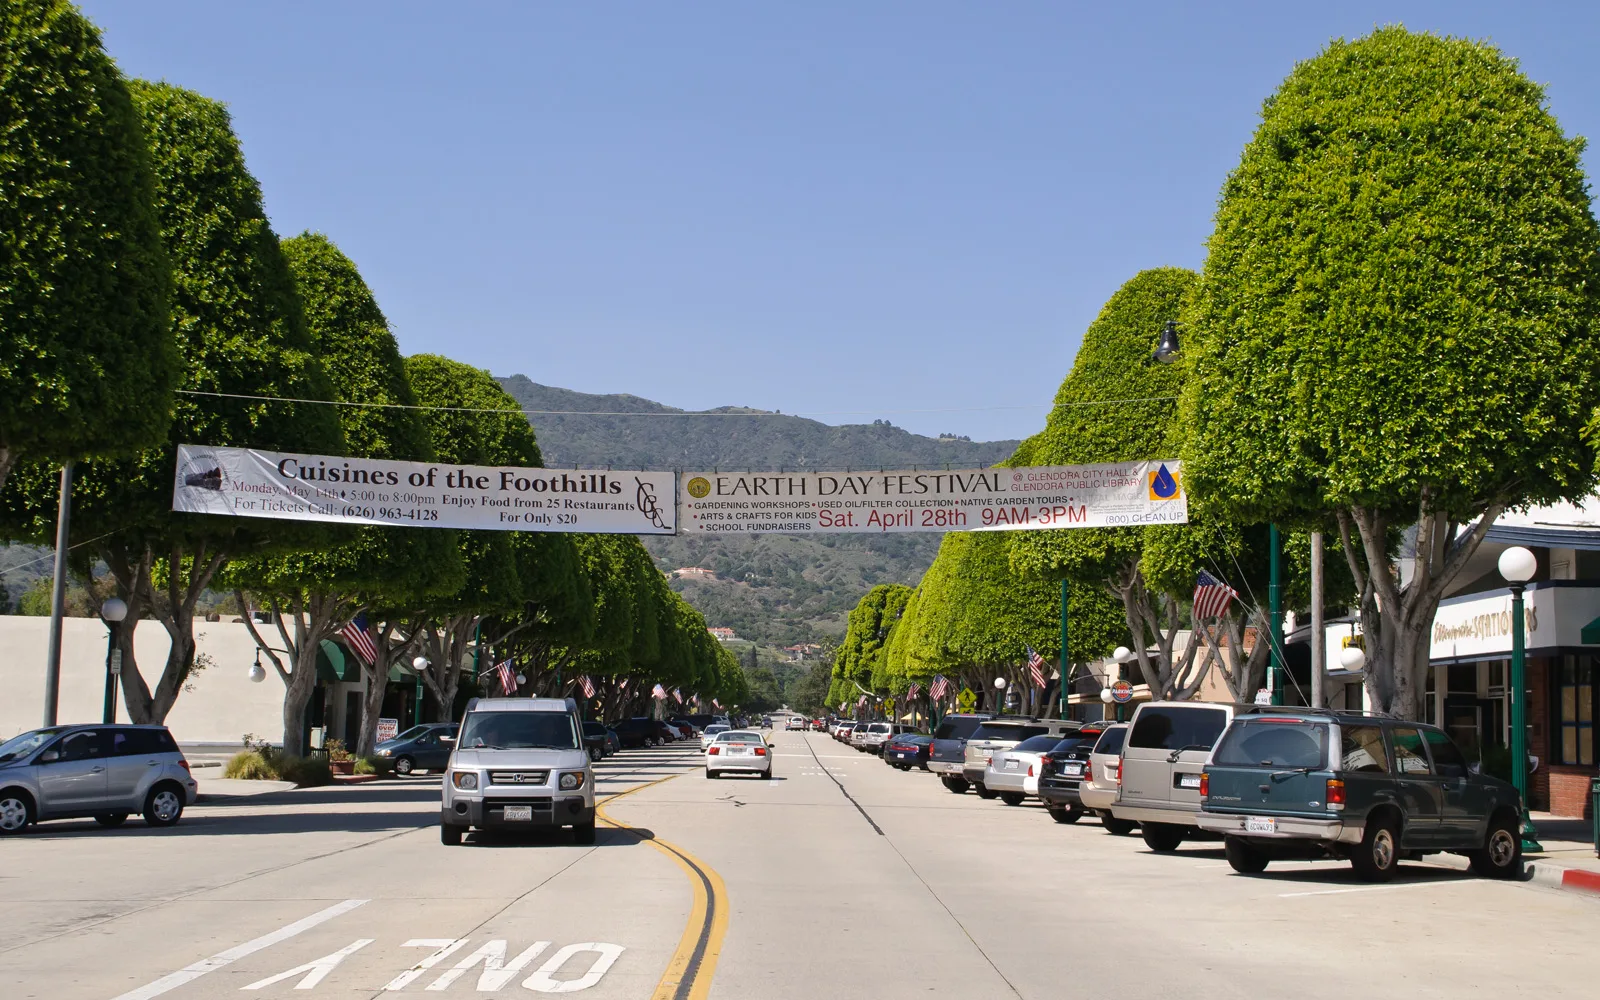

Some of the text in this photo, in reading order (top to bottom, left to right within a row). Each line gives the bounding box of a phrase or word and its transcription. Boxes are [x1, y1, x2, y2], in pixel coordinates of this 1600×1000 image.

[278, 458, 622, 494] Cuisines of the Foothills
[1013, 472, 1024, 482] @
[1028, 471, 1080, 482] GLENDORA
[1082, 470, 1104, 479] CITY
[1106, 468, 1130, 478] HALL
[716, 473, 1006, 496] EARTH DAY FESTIVAL
[1011, 478, 1142, 492] GLENDORA PUBLIC LIBRARY
[286, 485, 310, 500] May
[316, 486, 339, 500] 14th
[350, 490, 375, 502] 5:00
[378, 492, 389, 502] to
[393, 492, 436, 505] 8:00pm
[442, 494, 477, 508] Enjoy
[481, 496, 510, 507] Food
[514, 498, 543, 508] from
[547, 498, 560, 508] 25
[564, 499, 635, 511] Restaurants
[694, 502, 750, 510] GARDENING
[751, 501, 811, 510] WORKSHOPS
[817, 500, 842, 508] USED
[845, 500, 893, 508] OIL/FILTER
[895, 499, 954, 508] COLLECTION
[960, 496, 992, 506] NATIVE
[996, 496, 1036, 506] GARDEN
[1036, 496, 1068, 504] TOURS
[234, 496, 256, 508] For
[260, 498, 304, 514] Tickets
[308, 502, 338, 516] Call:
[342, 506, 375, 520] (626)
[379, 507, 438, 521] 963-4128
[500, 512, 578, 526] For Only $20
[700, 512, 724, 520] ARTS
[736, 512, 772, 520] CRAFTS
[774, 512, 794, 520] FOR
[796, 512, 817, 520] KIDS
[818, 504, 1086, 531] Sat. April 28th 9AM-3PM
[1106, 512, 1184, 524] (800) CLEAN UP
[706, 522, 812, 531] SCHOOL FUNDRAISERS
[239, 938, 626, 992] ONLY
